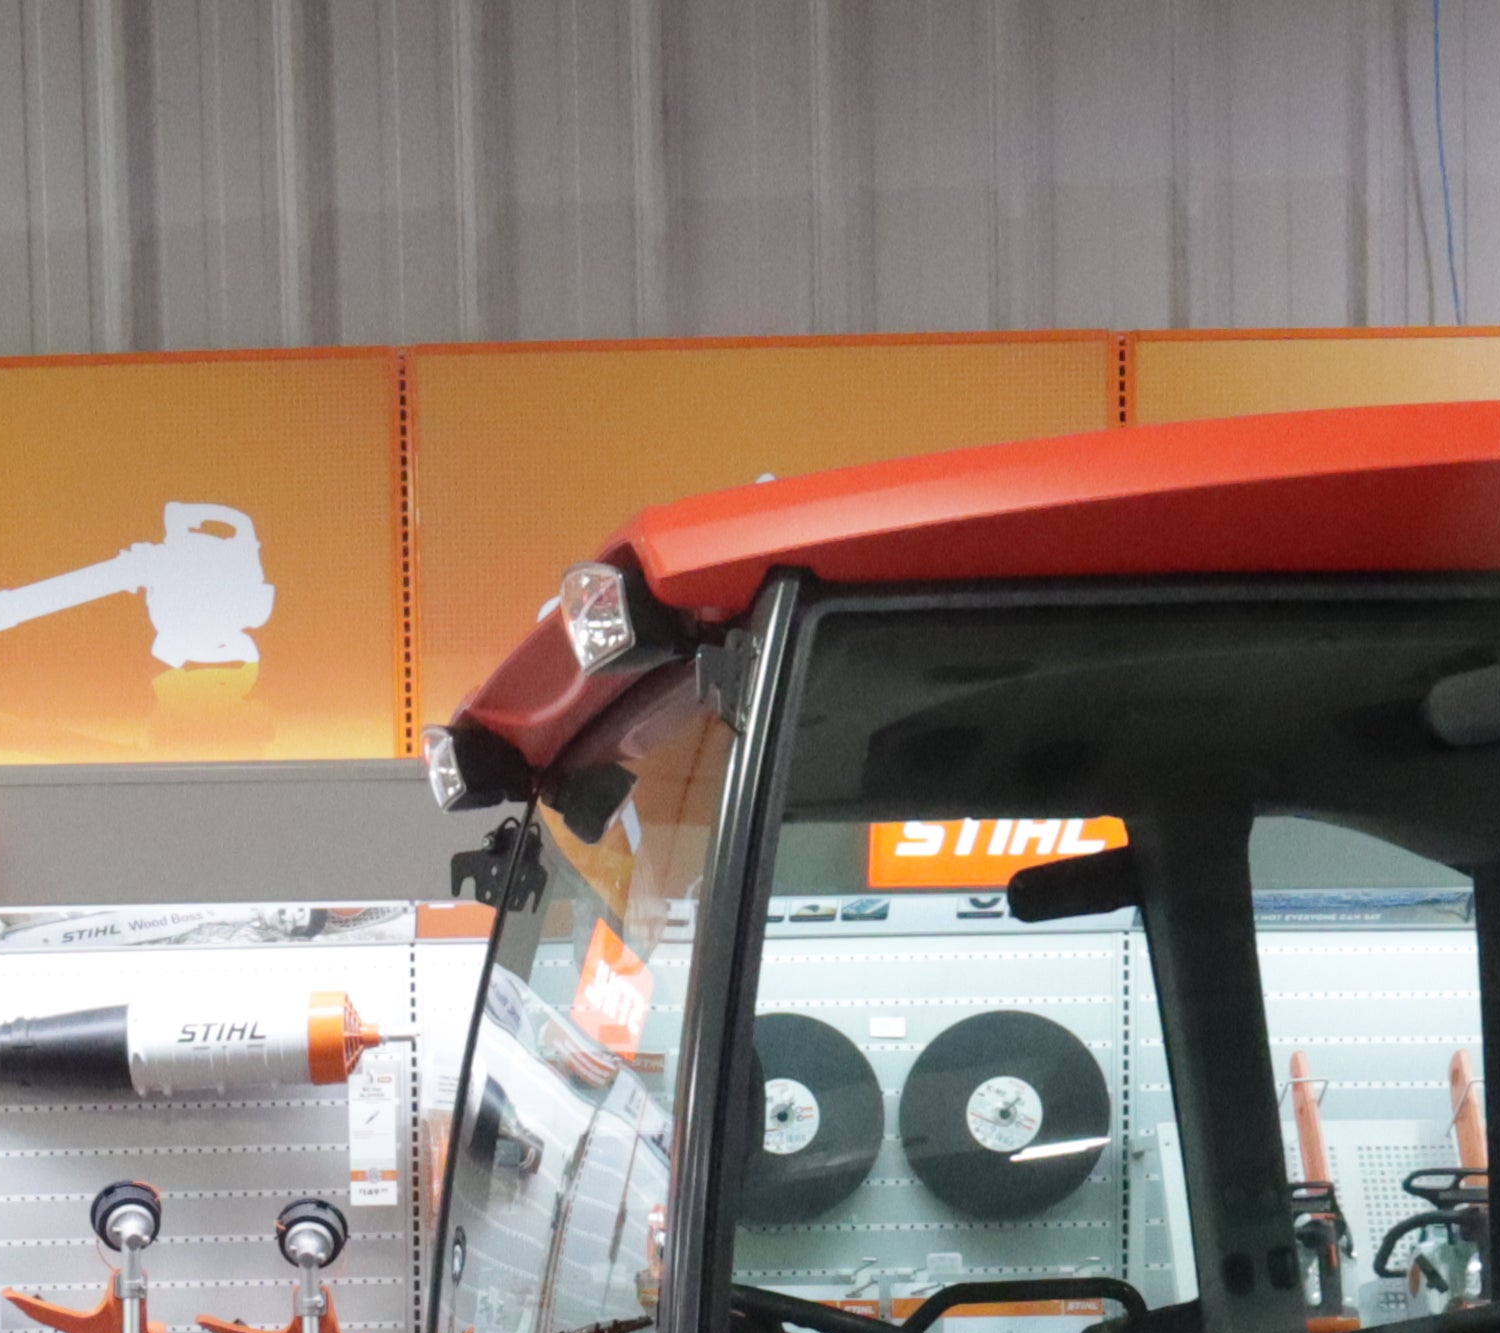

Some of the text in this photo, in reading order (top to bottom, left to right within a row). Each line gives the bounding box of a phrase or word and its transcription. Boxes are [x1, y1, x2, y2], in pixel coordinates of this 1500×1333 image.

[894, 818, 1106, 857] STIHL
[61, 923, 121, 945] STIHL
[128, 914, 168, 932] Wood
[177, 1021, 268, 1045] STIHL
[1067, 1302, 1100, 1311] STIHL
